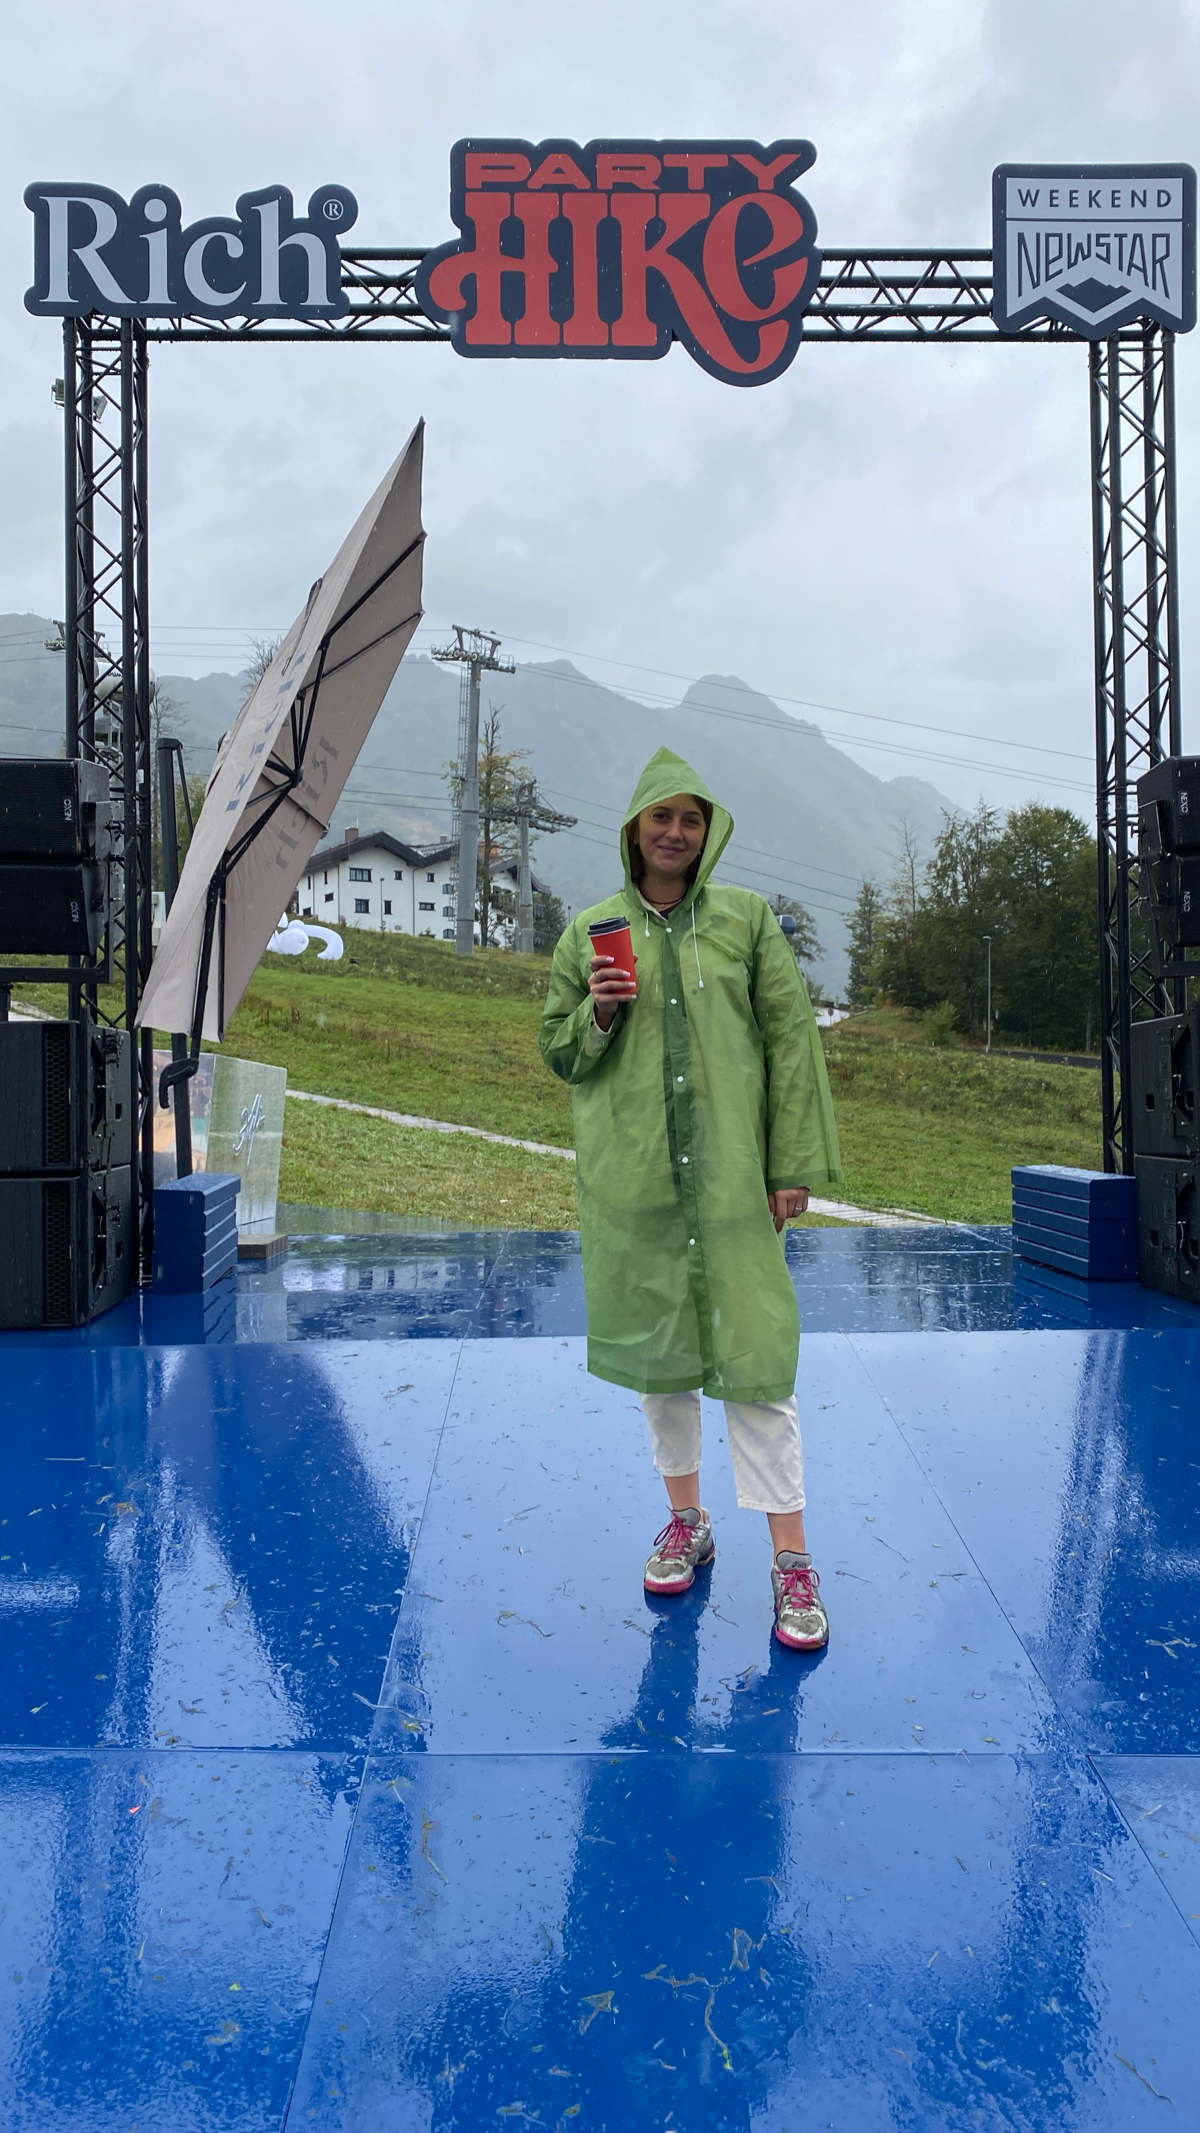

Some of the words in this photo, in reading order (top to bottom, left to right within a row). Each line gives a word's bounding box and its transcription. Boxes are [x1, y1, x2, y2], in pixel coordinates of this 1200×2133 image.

[465, 152, 801, 190] PARTY
[1017, 188, 1172, 208] WEEKEND
[63, 798, 72, 821] NEXO
[1180, 792, 1189, 813] NEXO
[70, 901, 79, 922] NEXO
[1183, 891, 1191, 912] NEXO
